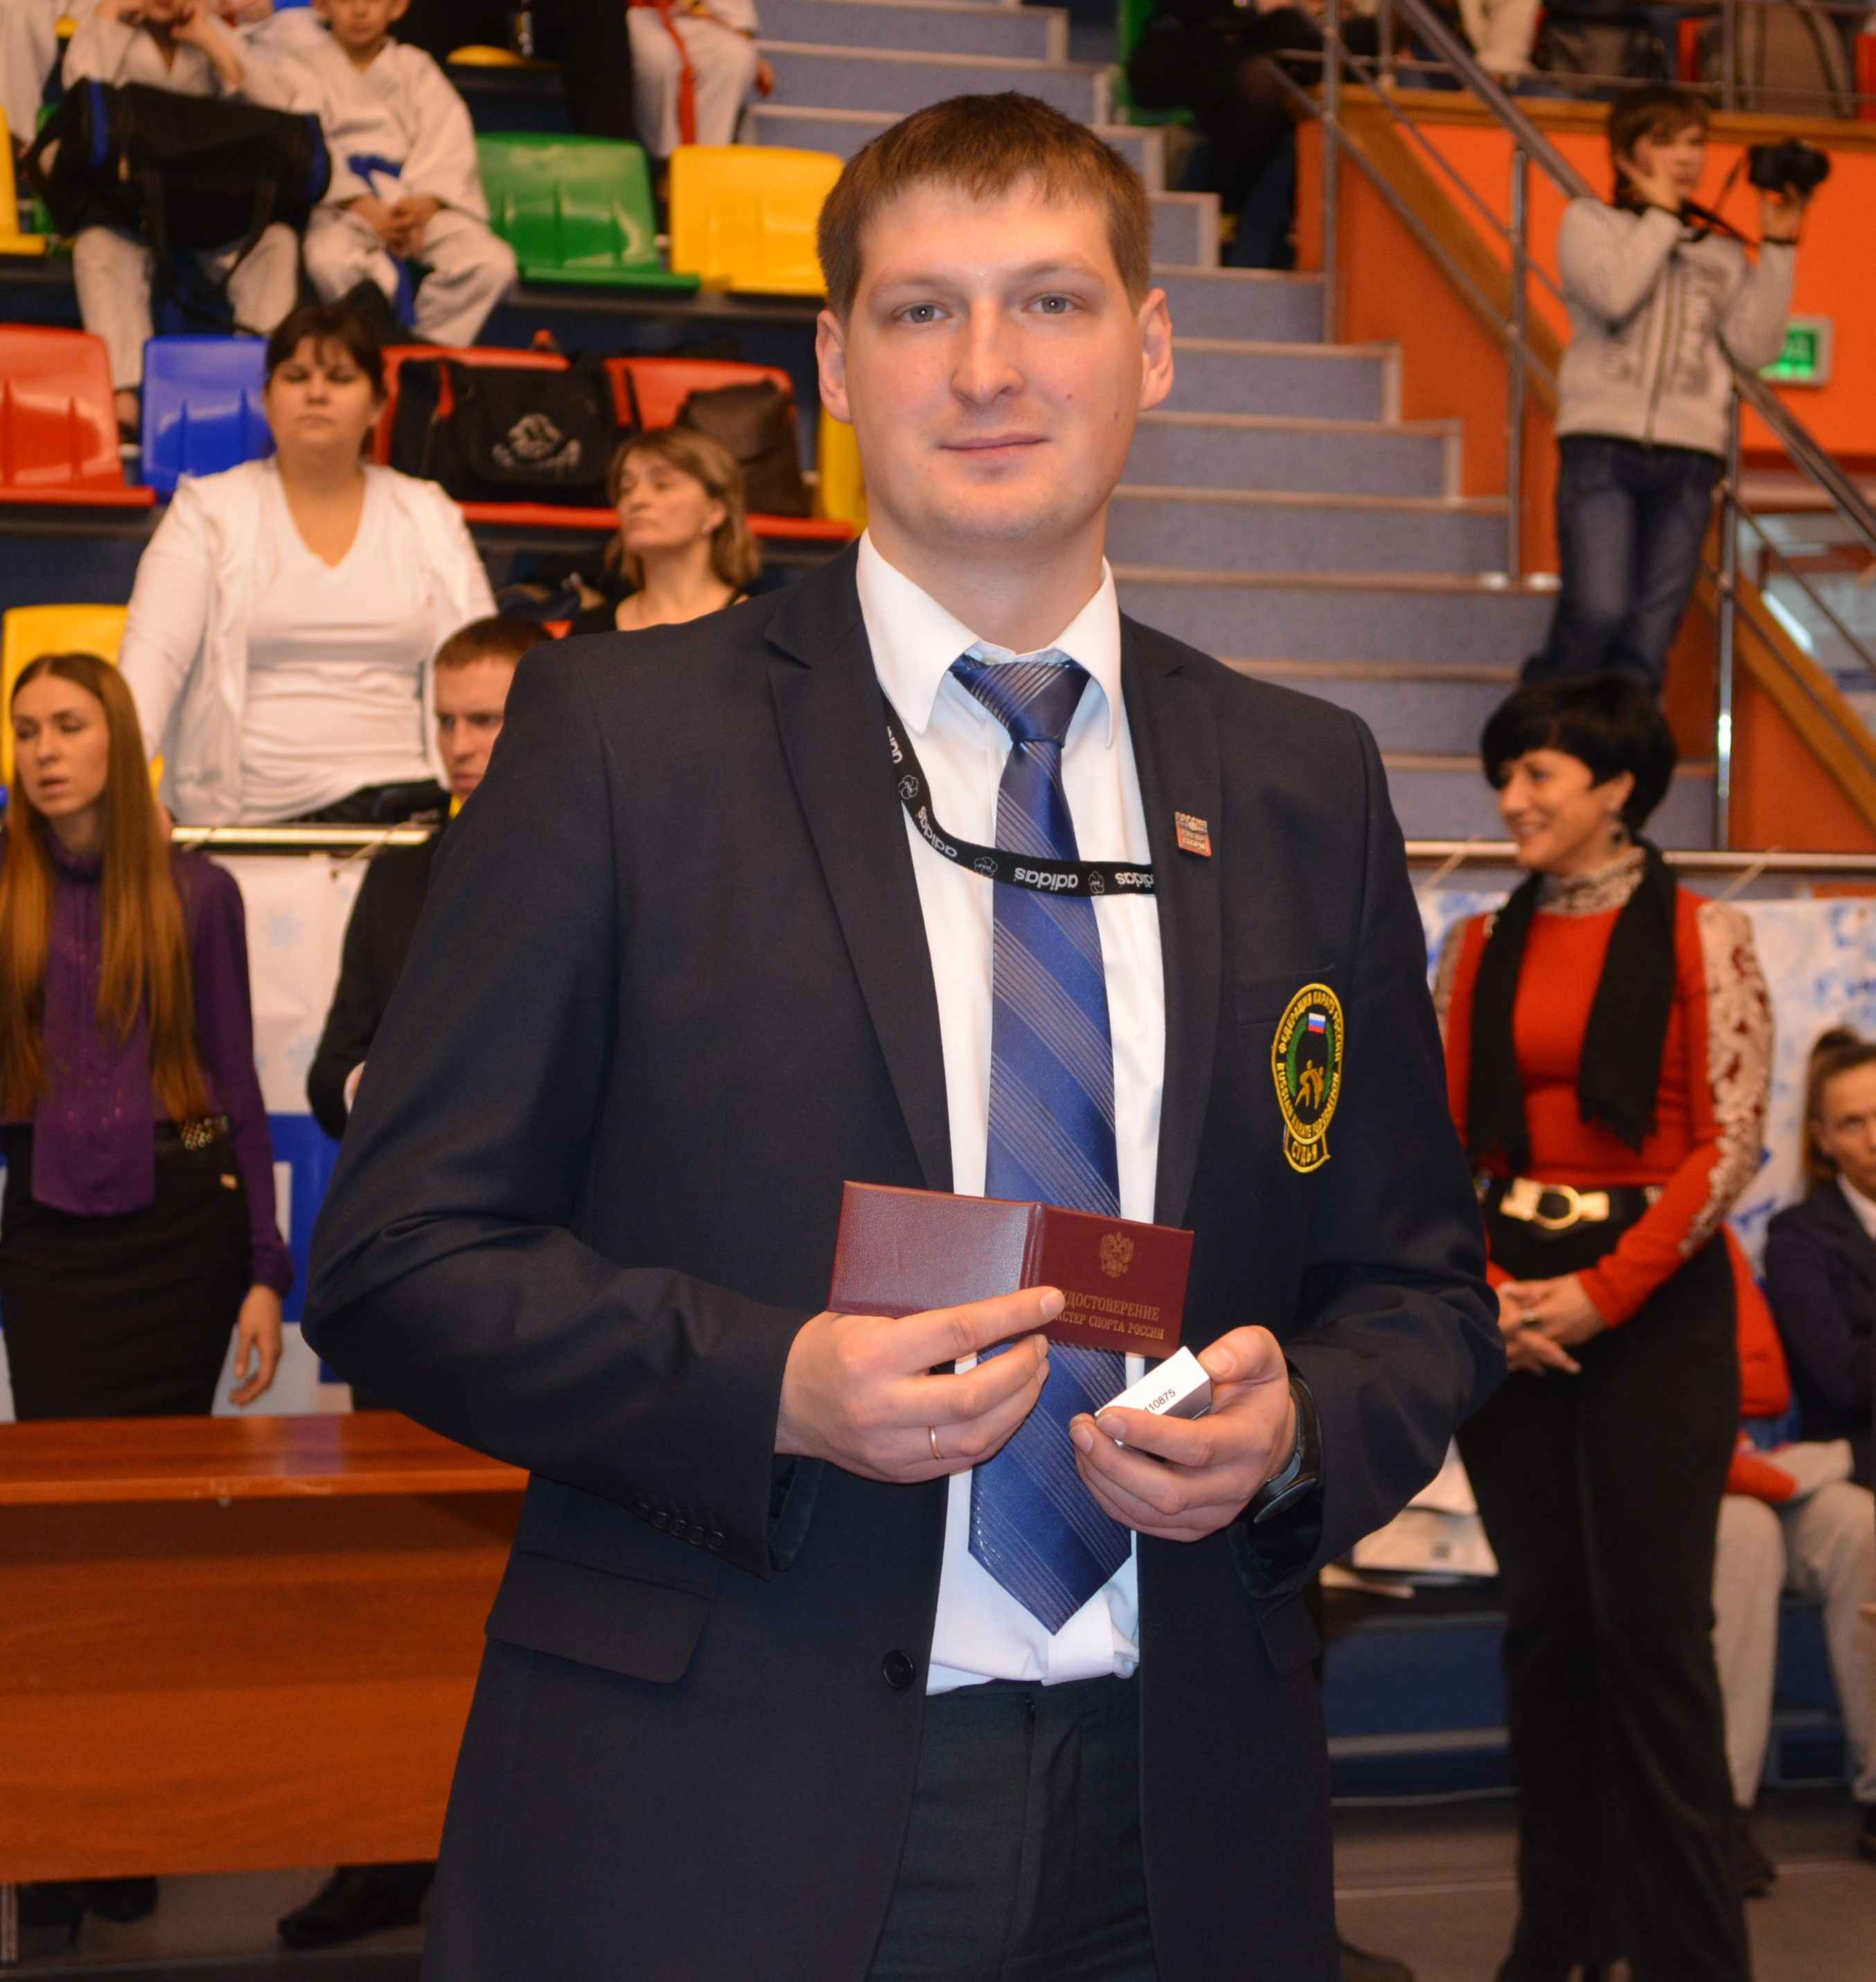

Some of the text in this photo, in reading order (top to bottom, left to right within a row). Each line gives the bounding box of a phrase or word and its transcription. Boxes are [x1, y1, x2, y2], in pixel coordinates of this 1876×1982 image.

[917, 805, 958, 858] adidas
[1014, 867, 1079, 891] adidas
[1115, 871, 1154, 887] didas
[1088, 1316, 1124, 1334] СПОРТА
[1127, 1323, 1165, 1340] РОССИИ
